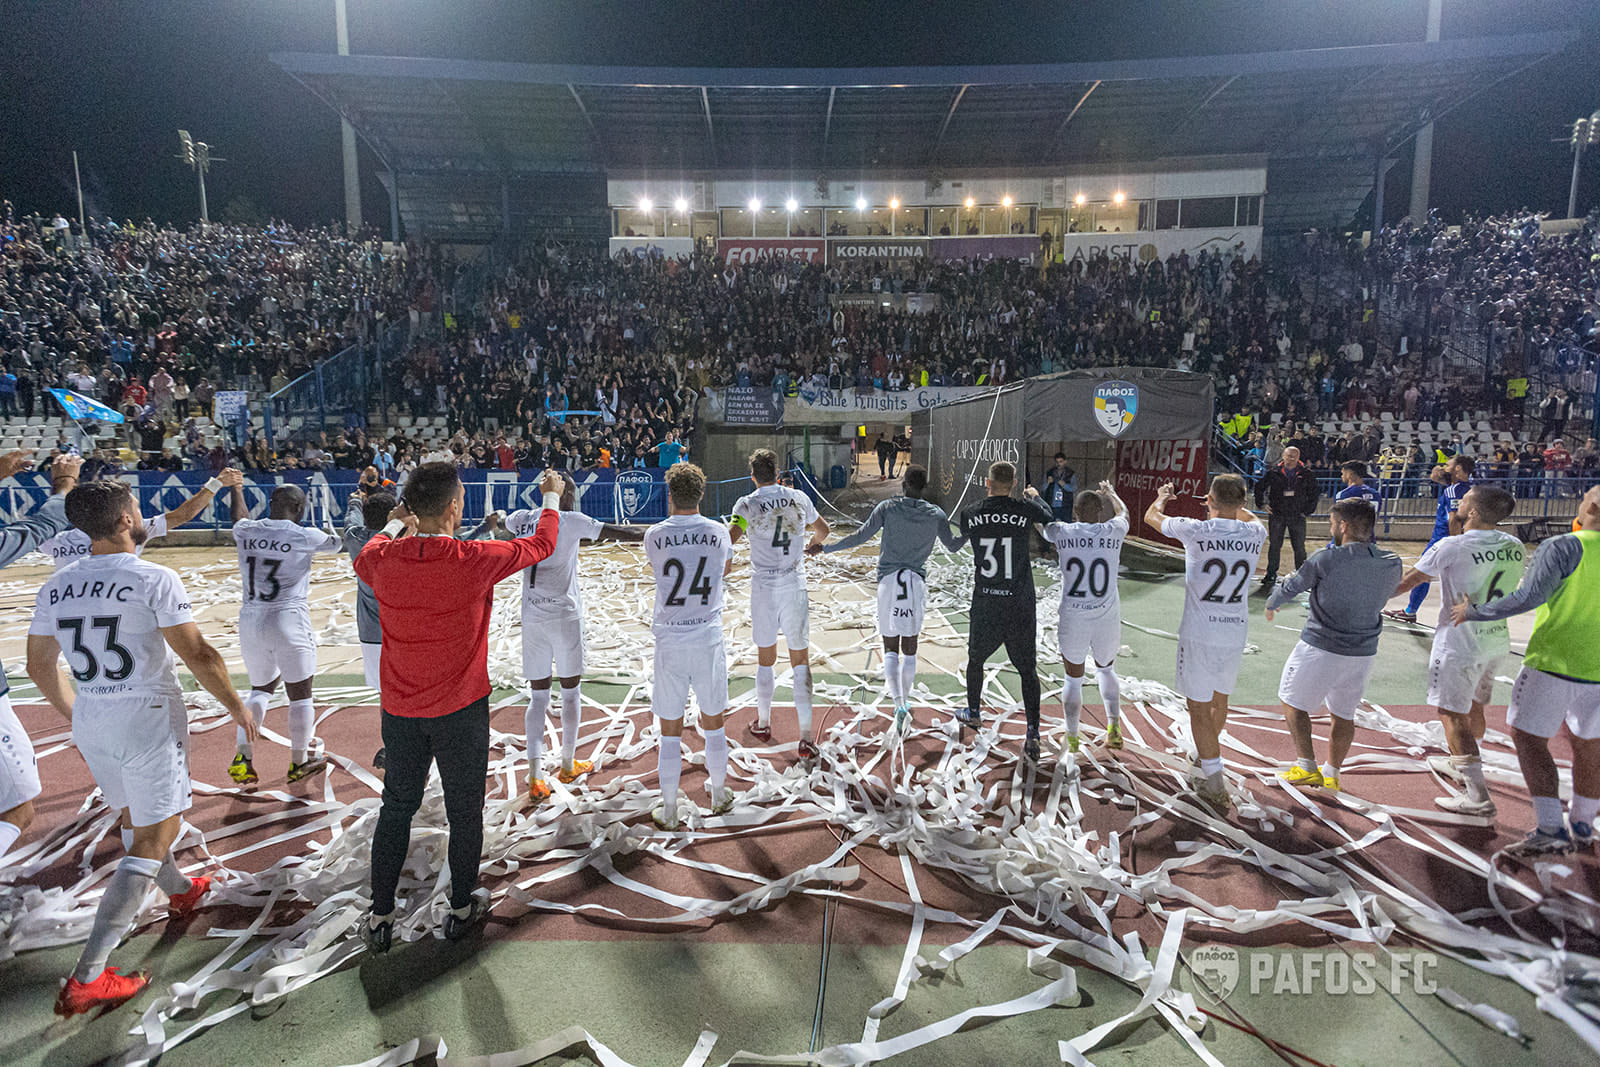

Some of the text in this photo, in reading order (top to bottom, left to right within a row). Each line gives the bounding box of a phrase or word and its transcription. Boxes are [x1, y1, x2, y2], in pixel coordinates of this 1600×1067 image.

[837, 246, 923, 257] KORANTINA
[818, 389, 847, 408] Blue
[854, 391, 908, 411] Knights
[1097, 388, 1135, 397] ΠΑΦΟΣ
[956, 439, 969, 459] CAP
[979, 438, 1019, 465] GEORGES
[1119, 439, 1204, 472] FONBET
[1118, 472, 1202, 495] FONBET.CMCY
[760, 498, 797, 513] KVIDA
[968, 513, 1027, 528] ANTOSCH
[243, 539, 291, 553] IKOKO
[654, 533, 722, 550] VALAKARI
[771, 515, 792, 555] 4
[1057, 538, 1120, 550] JUNIOR REIS
[979, 537, 1012, 579] 31
[1472, 549, 1523, 565] HOCKO
[246, 556, 283, 601] 13
[663, 556, 712, 606] 24
[1066, 557, 1109, 597] 20
[1201, 558, 1250, 604] 22
[50, 581, 133, 606] BAJRIC
[56, 614, 135, 682] 33
